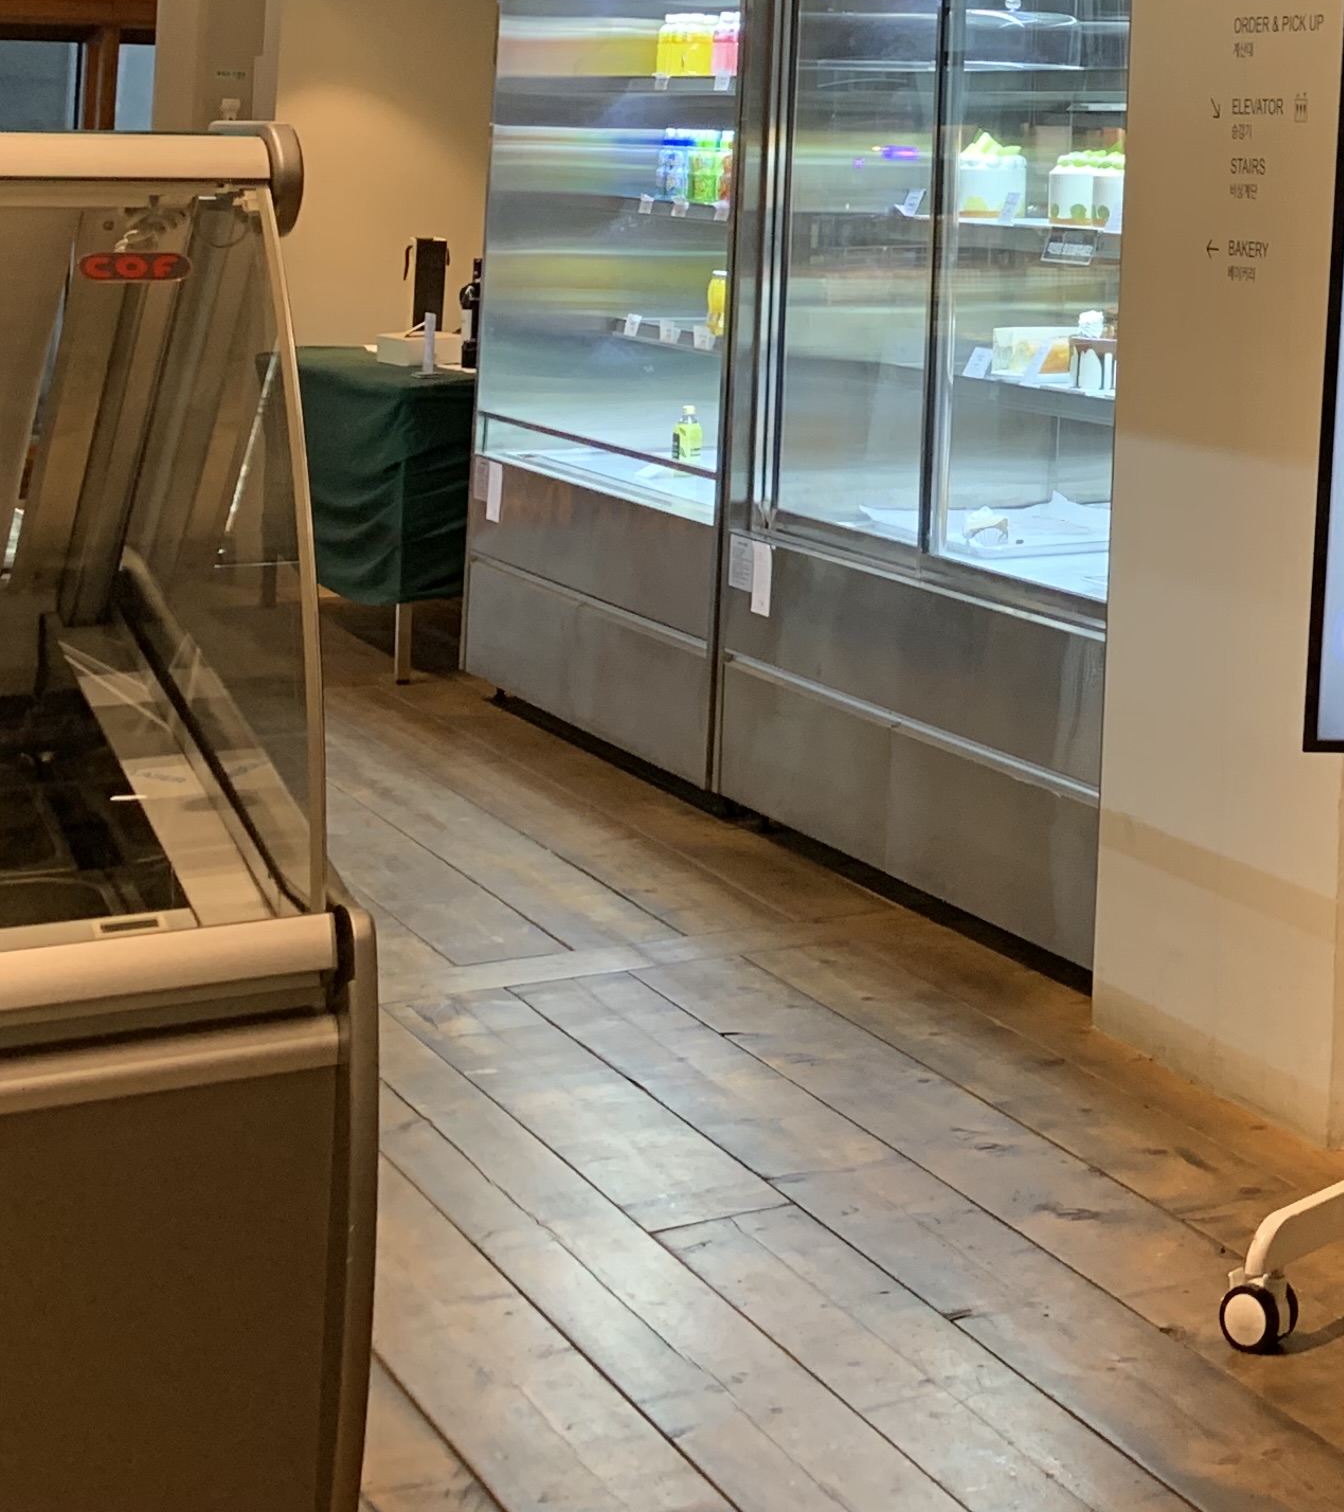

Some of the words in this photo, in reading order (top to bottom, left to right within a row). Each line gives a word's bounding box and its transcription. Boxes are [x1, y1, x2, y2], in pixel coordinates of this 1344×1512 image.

[1233, 16, 1270, 34] ORDER
[1271, 15, 1280, 33] &
[1281, 14, 1307, 33] PICK
[1308, 13, 1325, 32] UP
[1231, 97, 1284, 116] ELEVATOR
[1231, 123, 1253, 140] 승강기
[1230, 157, 1266, 175] STAIRS
[1228, 240, 1269, 259] BAKERY
